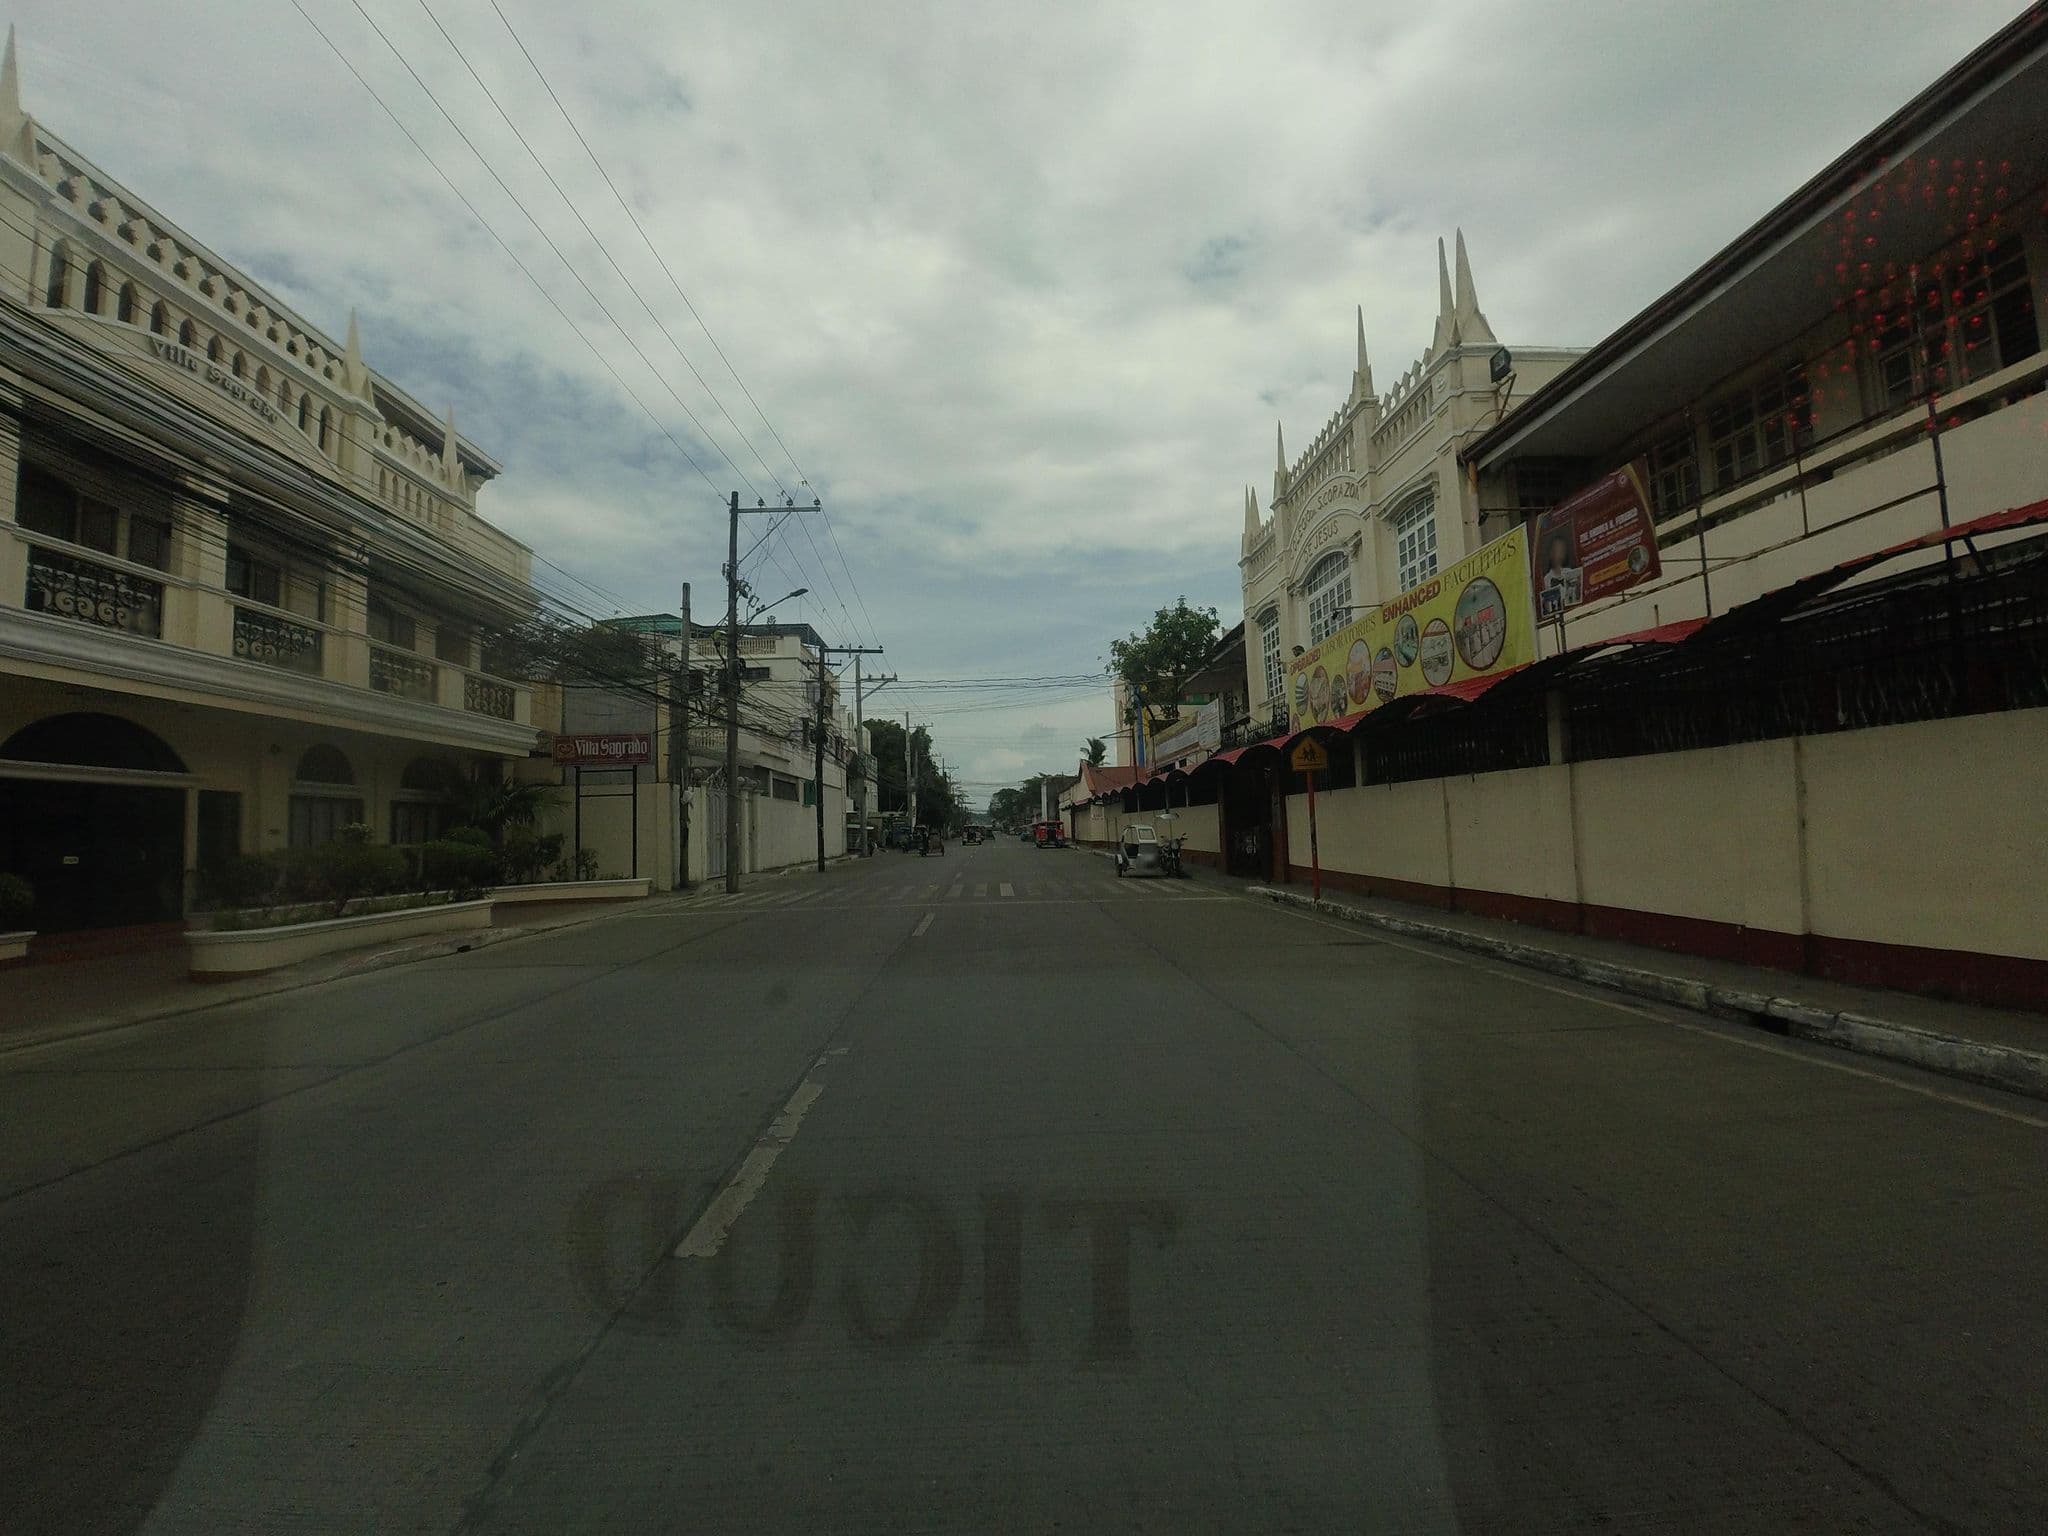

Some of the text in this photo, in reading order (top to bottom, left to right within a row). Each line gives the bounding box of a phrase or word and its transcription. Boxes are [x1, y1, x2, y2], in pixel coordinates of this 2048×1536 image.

[1314, 520, 1338, 549] JESUS
[1383, 537, 1517, 624] ENHANCED FACILITIES
[575, 738, 649, 759] Villa Sagrado
